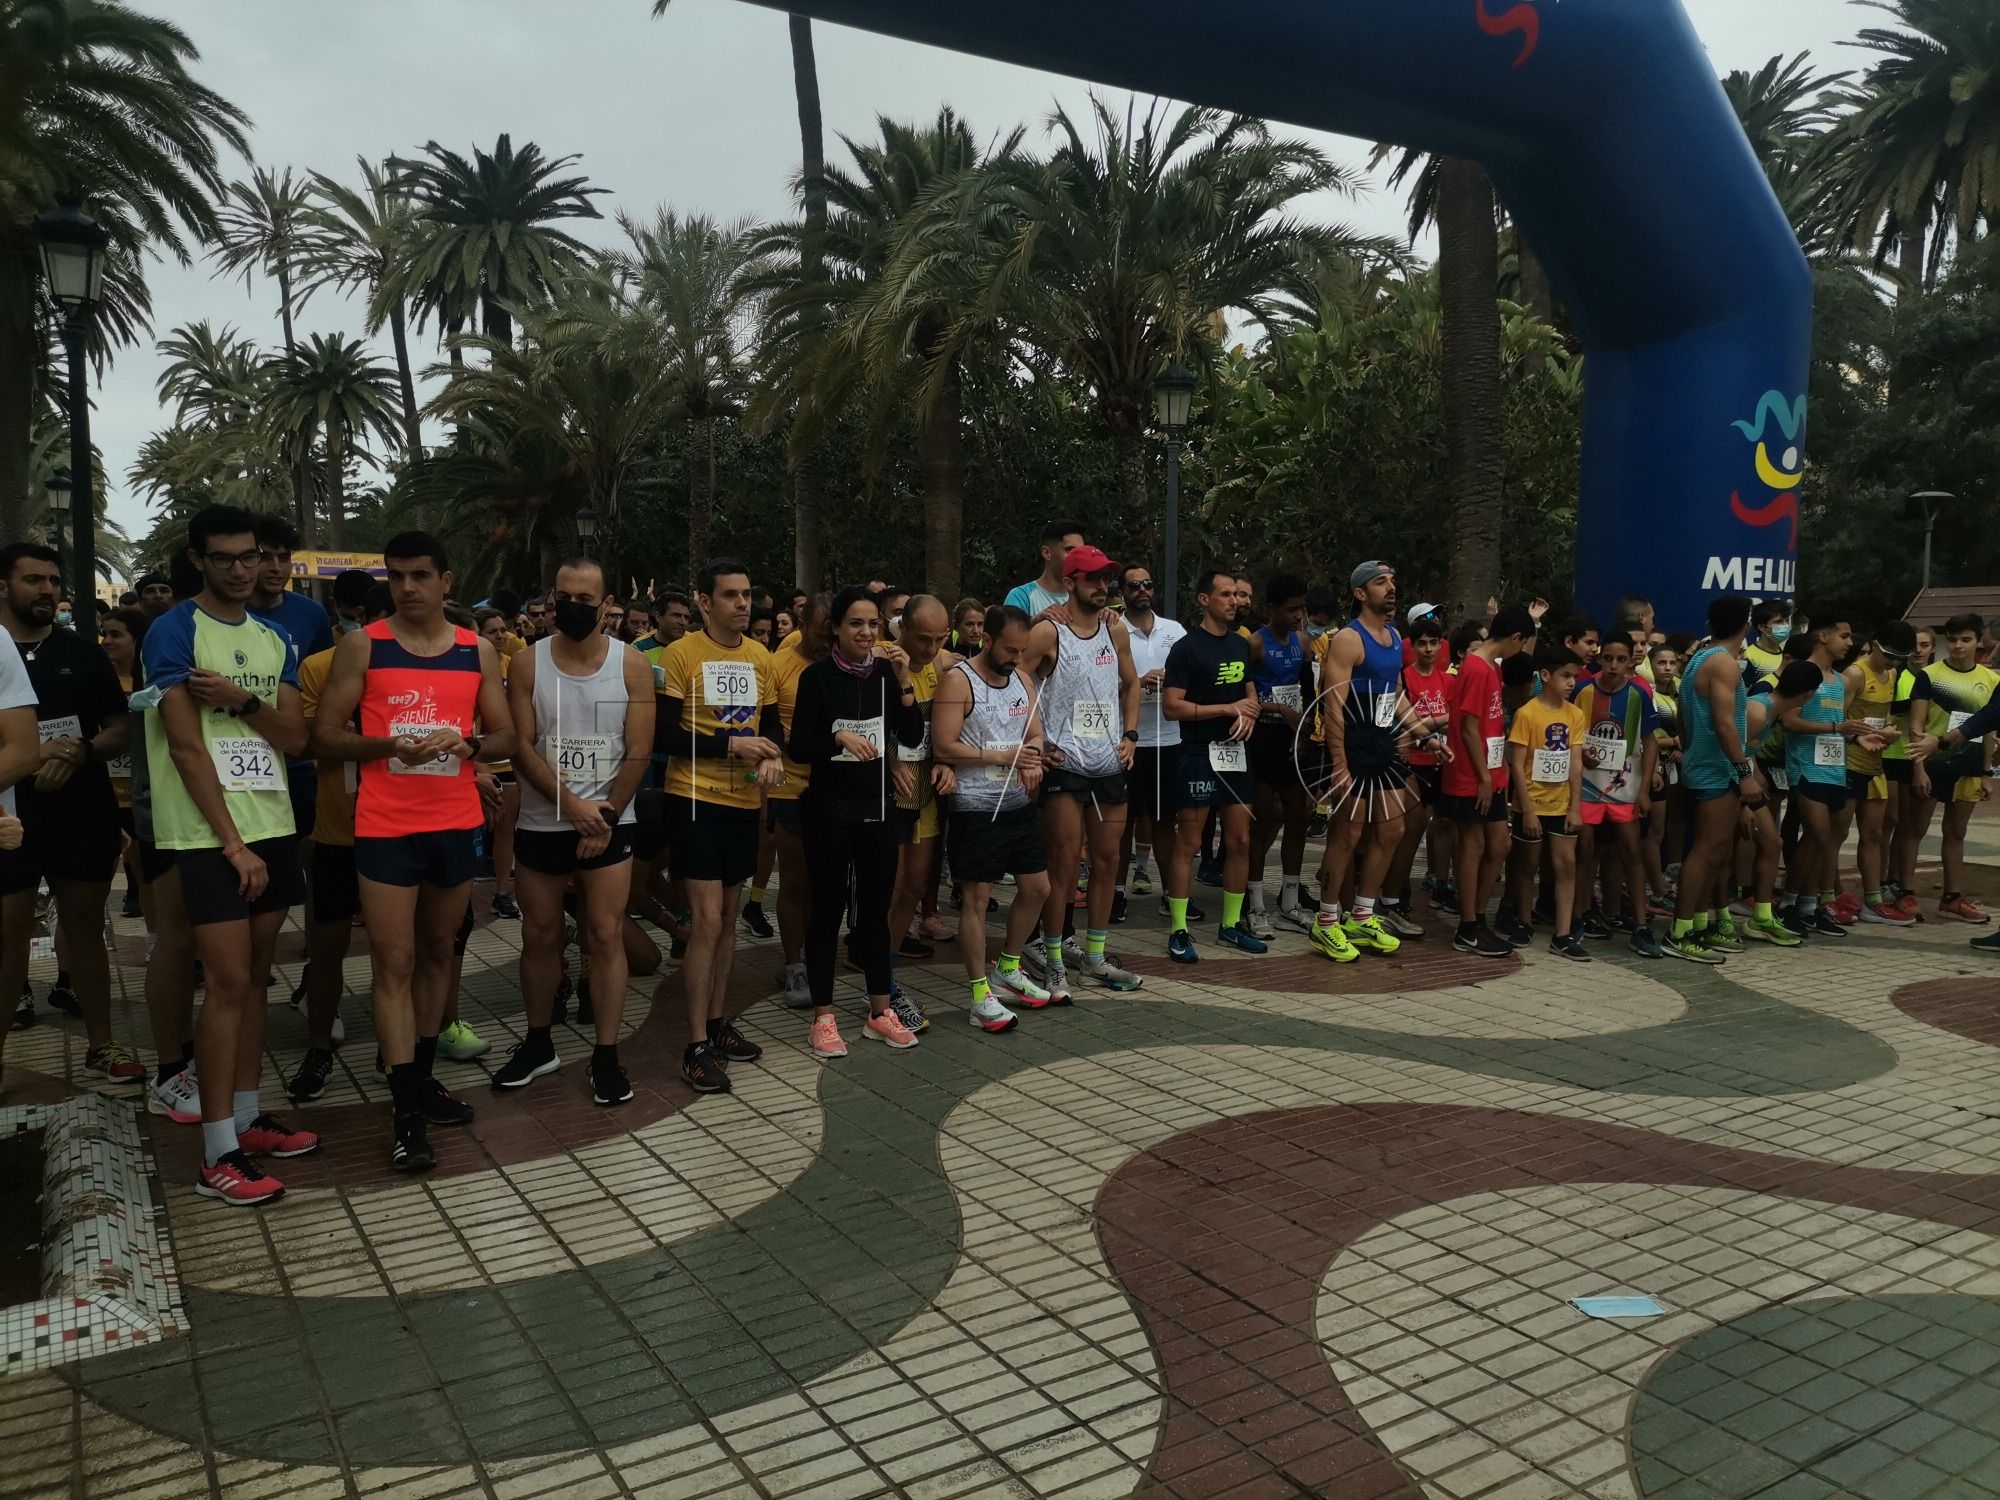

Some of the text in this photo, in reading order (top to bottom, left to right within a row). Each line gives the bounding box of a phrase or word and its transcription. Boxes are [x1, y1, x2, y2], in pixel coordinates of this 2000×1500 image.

[323, 557, 352, 566] CARRERA
[718, 664, 752, 672] CARRERA
[717, 676, 749, 694] 509
[218, 741, 229, 749] VI
[562, 738, 607, 746] CARRERA
[1217, 750, 1239, 763] 457
[1822, 746, 1842, 759] 336
[230, 755, 274, 777] 342
[559, 751, 596, 770] 401
[1542, 761, 1567, 774] 309
